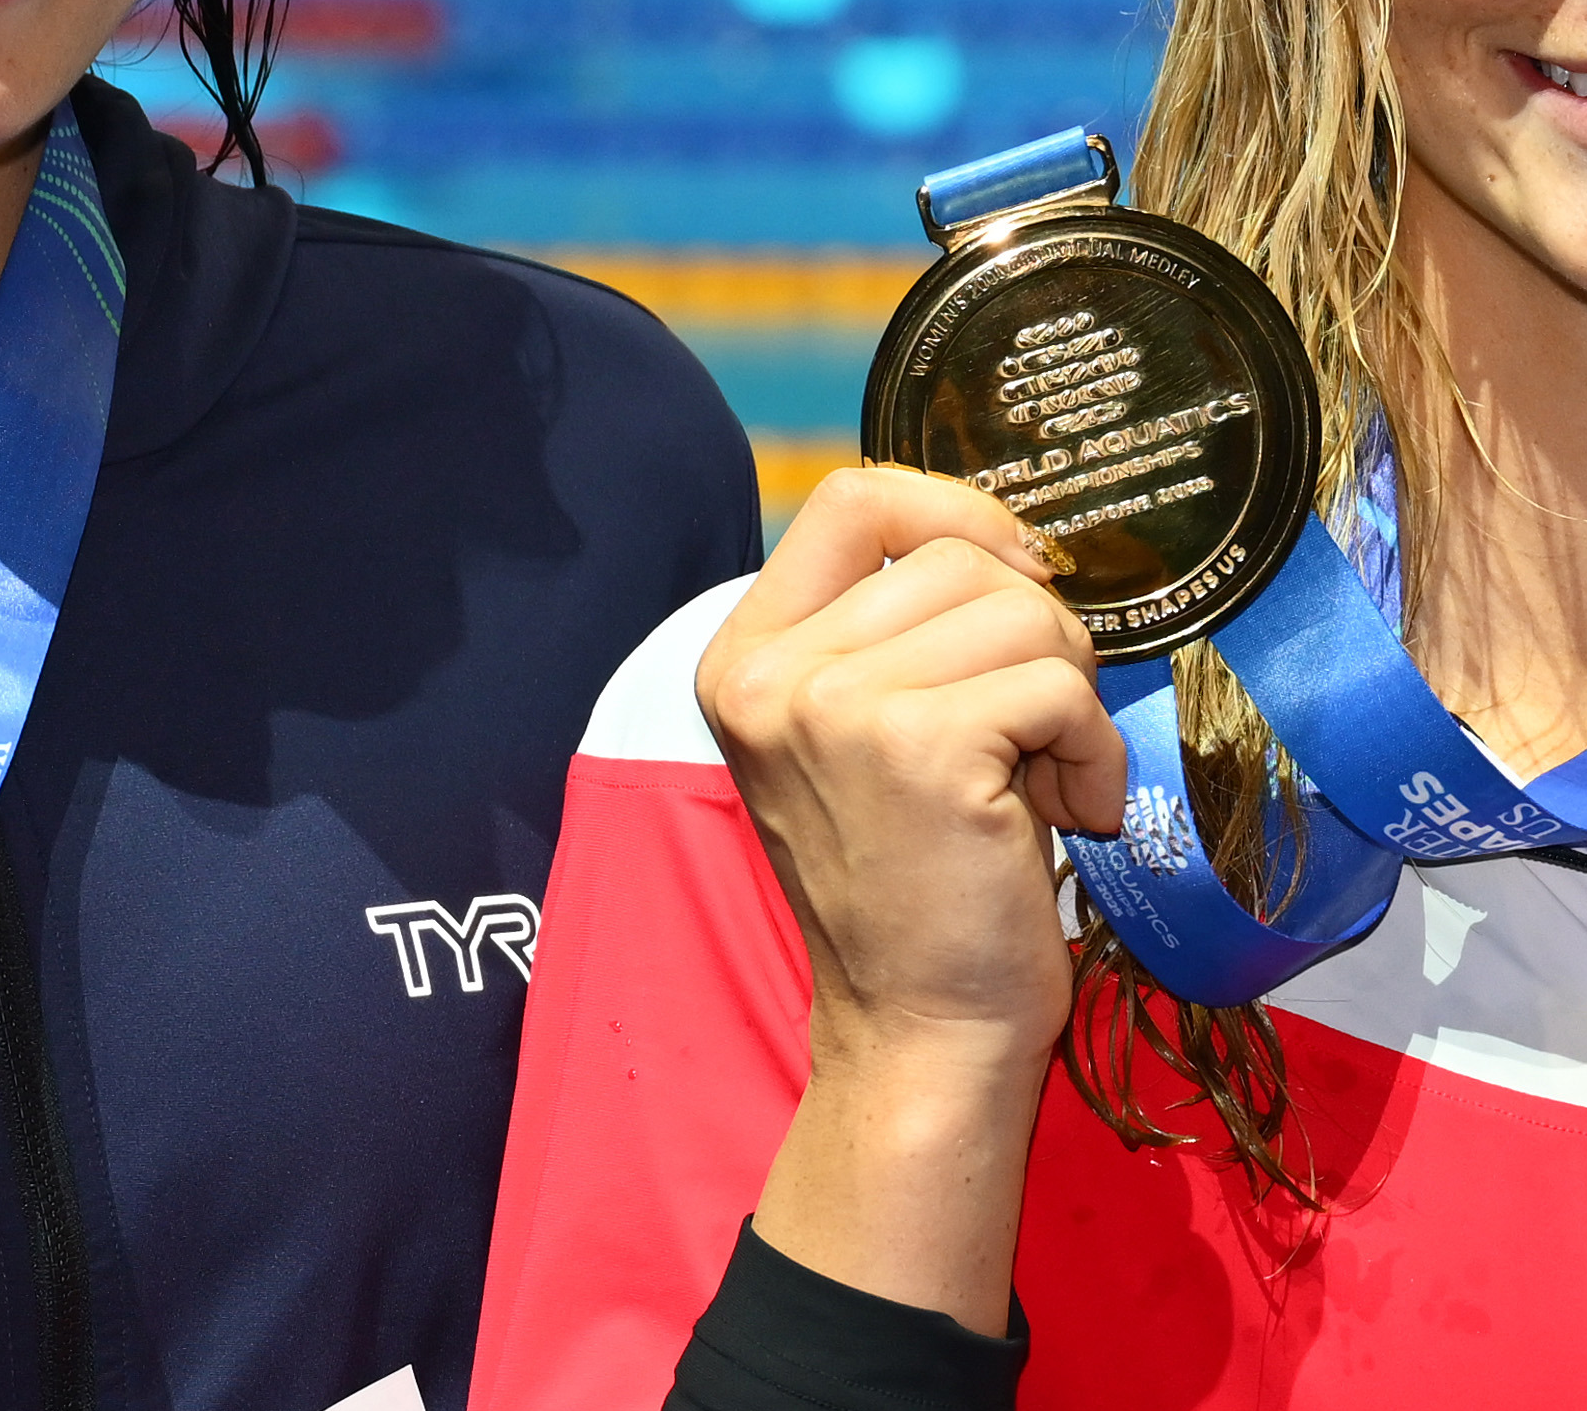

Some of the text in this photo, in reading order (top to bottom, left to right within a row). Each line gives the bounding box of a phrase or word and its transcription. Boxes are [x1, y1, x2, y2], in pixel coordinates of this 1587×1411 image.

[1129, 245, 1201, 291] MEDLEY
[965, 392, 1253, 494] ORLD AQUATICS
[1004, 439, 1204, 514] CHAMPIONSHIPS
[1126, 542, 1247, 628] SHAPES US
[1399, 771, 1534, 852] APES
[1497, 803, 1562, 840] US
[364, 893, 542, 997] TYR
